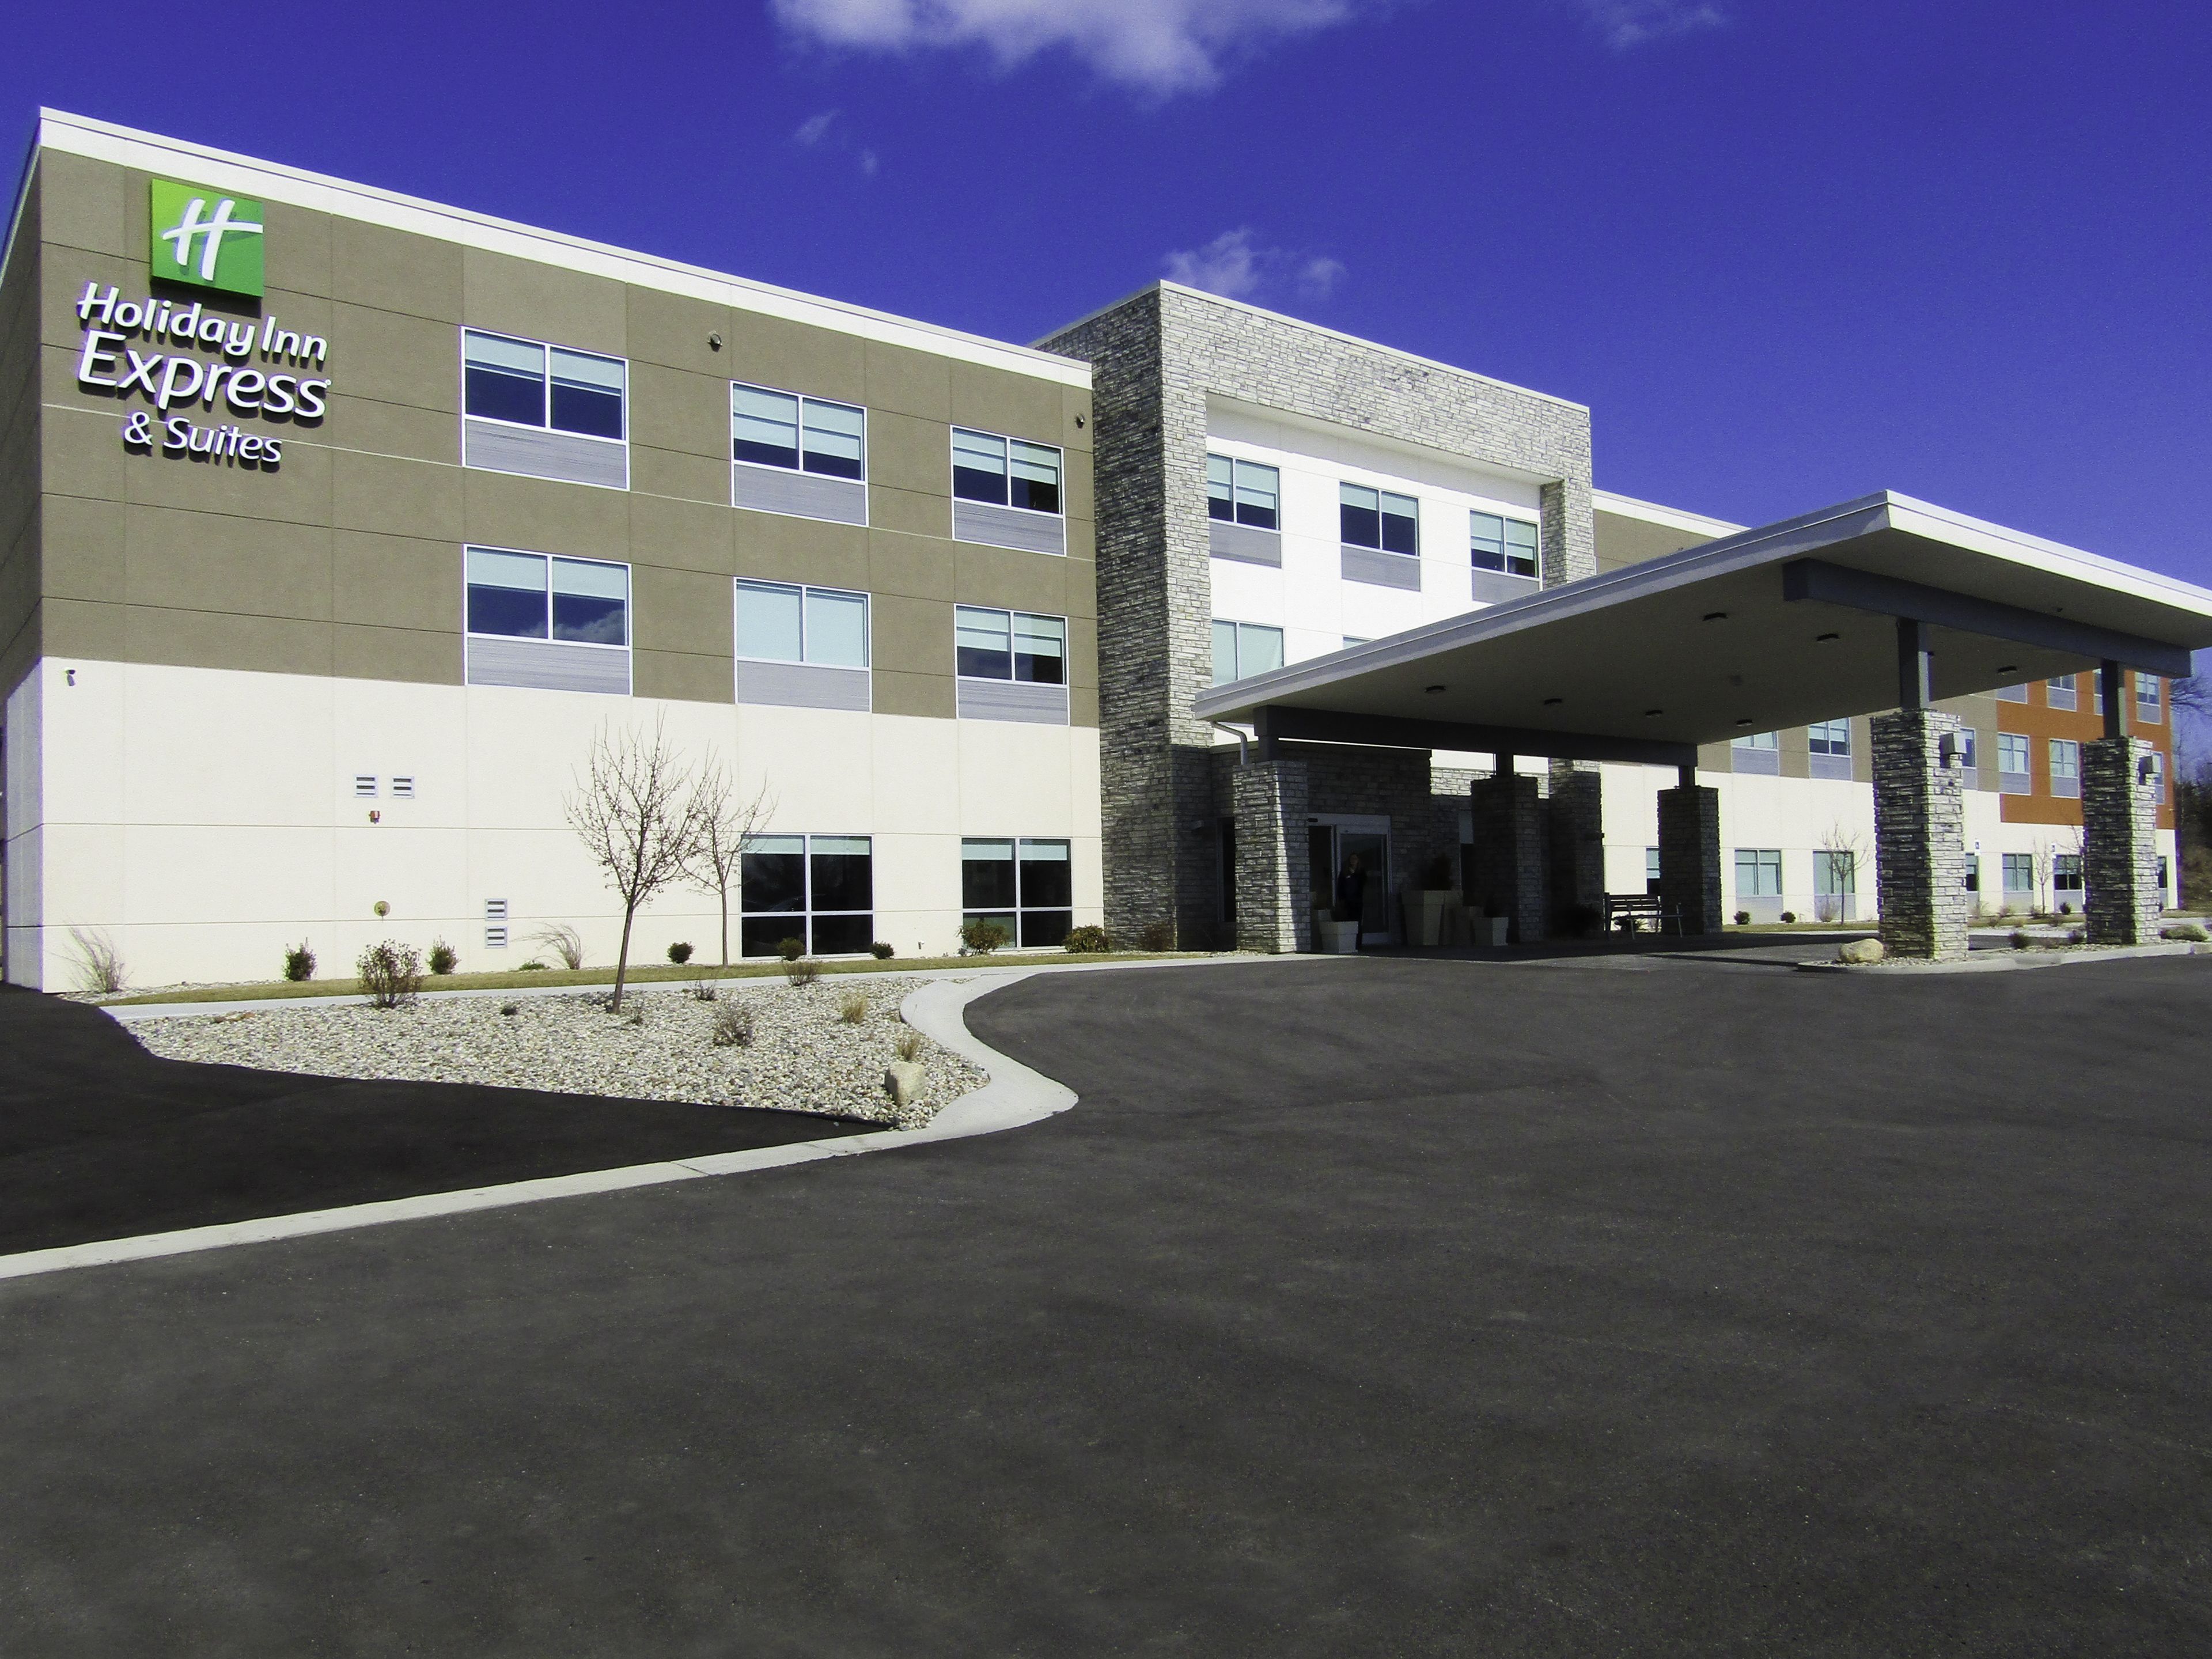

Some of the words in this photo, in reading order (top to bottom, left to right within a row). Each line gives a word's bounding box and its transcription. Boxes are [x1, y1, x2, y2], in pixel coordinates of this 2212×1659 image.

[77, 282, 256, 356] Holiday
[262, 316, 328, 362] Inn
[78, 329, 328, 418] Express
[123, 411, 153, 446] &
[163, 416, 282, 463] Suites
